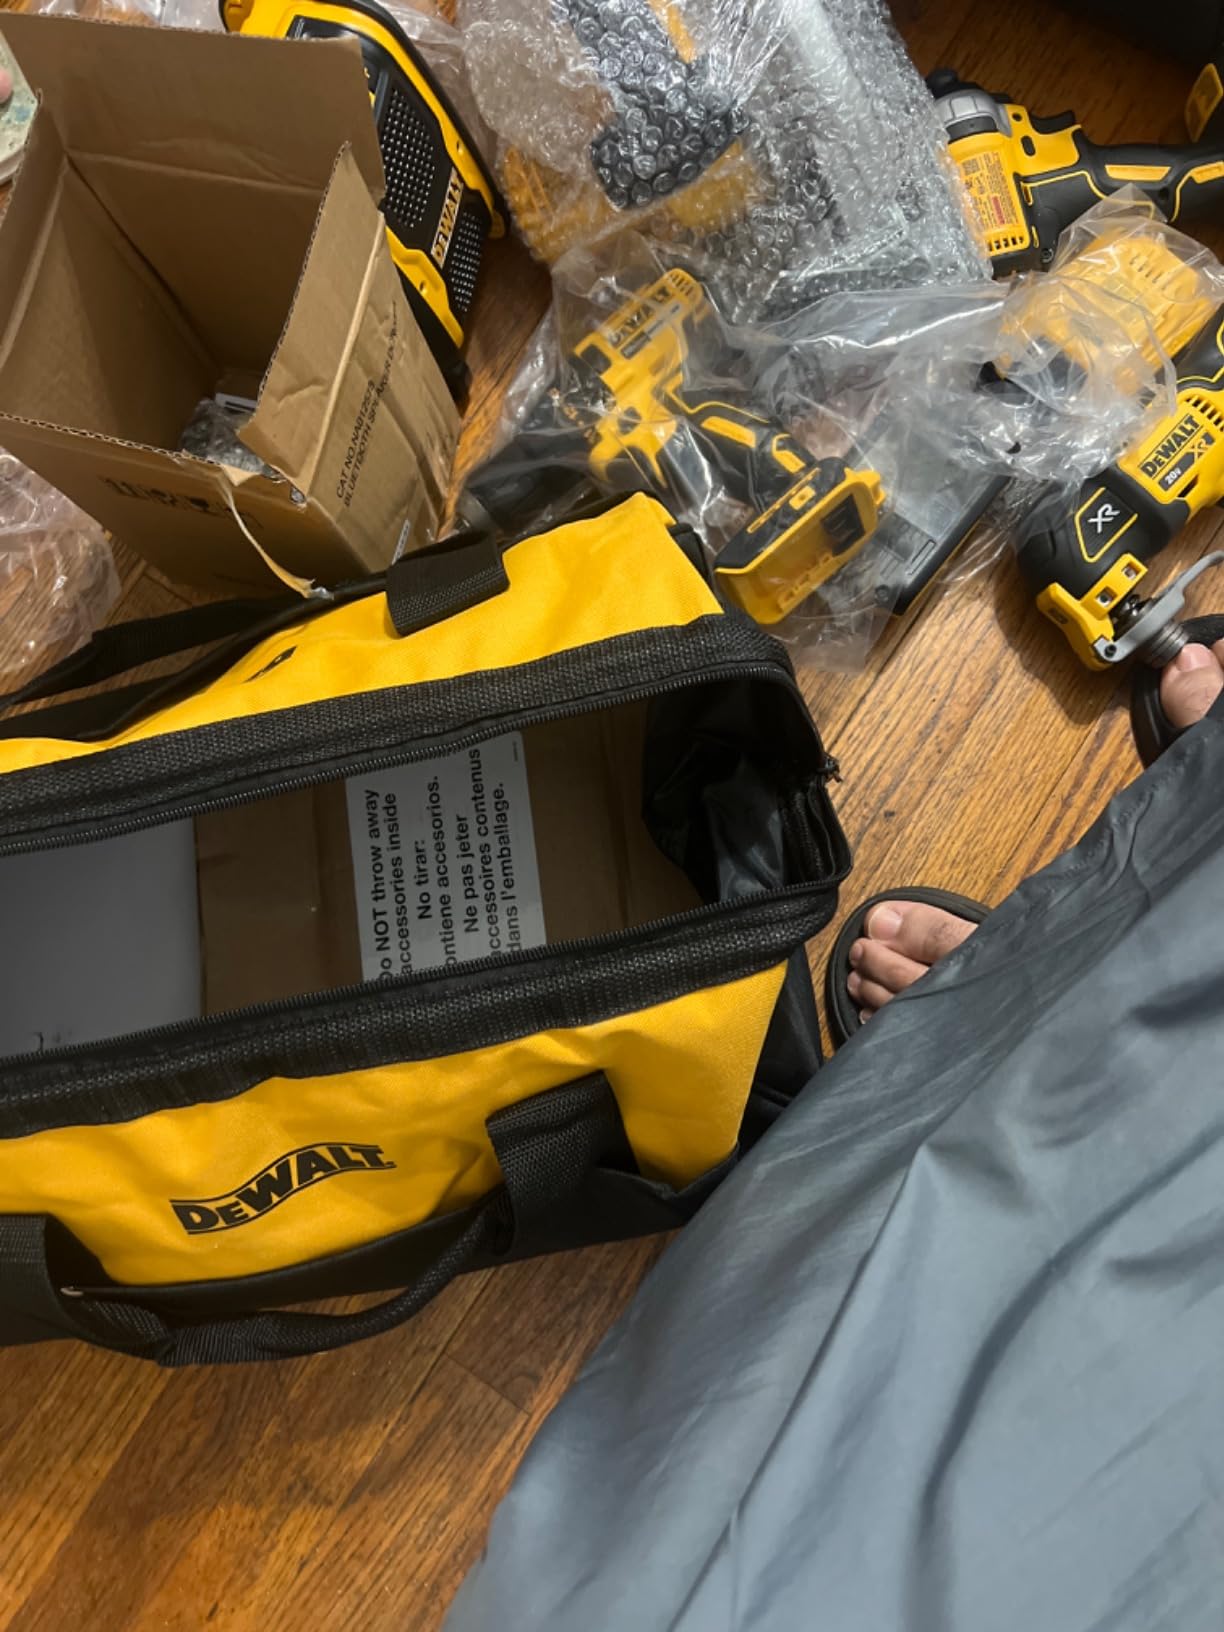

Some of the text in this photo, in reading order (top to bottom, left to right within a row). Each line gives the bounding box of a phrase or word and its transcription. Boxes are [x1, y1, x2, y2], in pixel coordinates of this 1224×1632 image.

[336, 476, 348, 499] CAT
[344, 425, 372, 507] BLUETOOTH
[1087, 503, 1120, 534] XR
[364, 789, 381, 839] away
[468, 748, 490, 837] contenus
[371, 846, 386, 902] throw
[413, 839, 433, 920] No tirar:
[426, 775, 458, 968] ontiene accesorios.
[456, 814, 480, 933] Ne pas jeter
[493, 782, 516, 902] l'emballage.
[382, 793, 413, 976] accessories inside
[372, 908, 391, 952] NOT
[507, 905, 522, 952] dans
